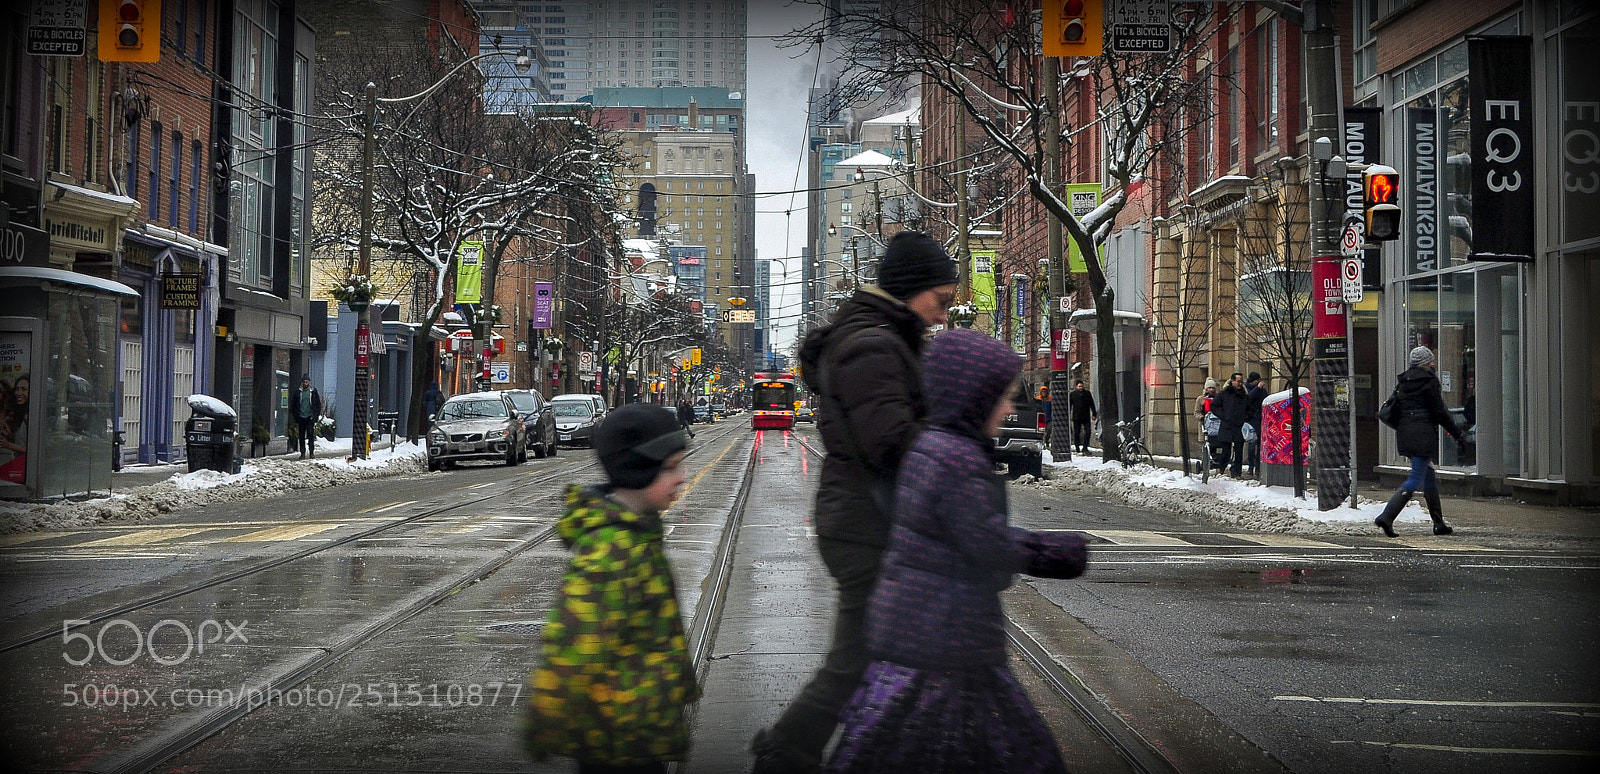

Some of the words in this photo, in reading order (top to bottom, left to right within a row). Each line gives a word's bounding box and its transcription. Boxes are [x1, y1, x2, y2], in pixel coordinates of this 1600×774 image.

[30, 29, 42, 39] TTC
[43, 31, 49, 39] &
[51, 30, 84, 40] BICYCLES
[1115, 26, 1127, 36] TTC
[1129, 27, 1135, 35] &
[1136, 27, 1168, 37] BICYCLES
[33, 41, 79, 52] EXCEPTED
[1119, 39, 1164, 48] EXCEPTED
[1485, 99, 1522, 192] EQ3
[1323, 278, 1342, 289] OLD
